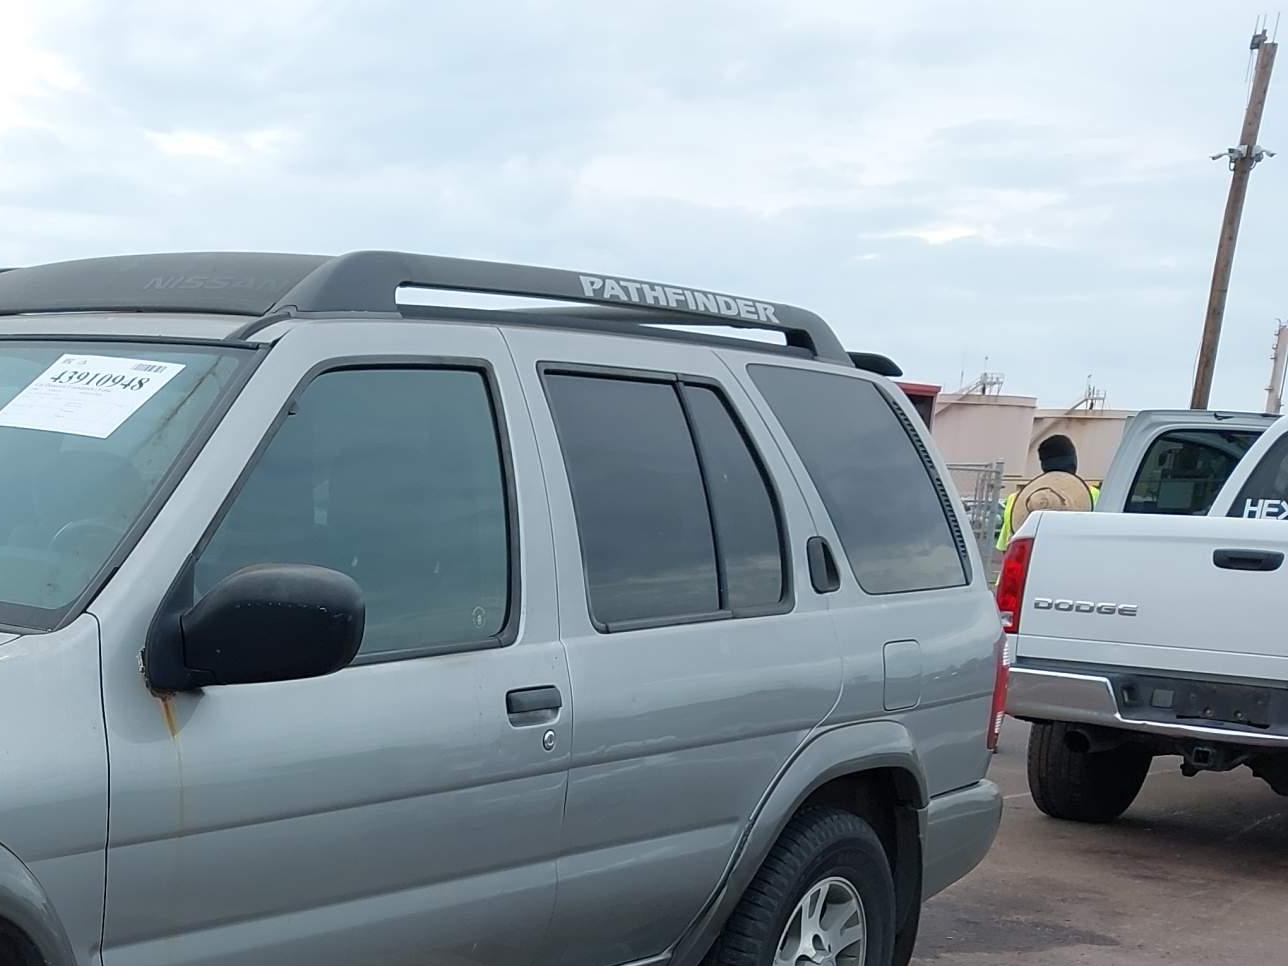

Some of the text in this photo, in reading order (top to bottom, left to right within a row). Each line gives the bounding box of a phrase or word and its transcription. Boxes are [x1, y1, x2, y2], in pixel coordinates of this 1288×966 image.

[579, 275, 780, 323] PATHFINDER
[50, 369, 150, 391] 43910948
[1033, 597, 1138, 617] DODGE
